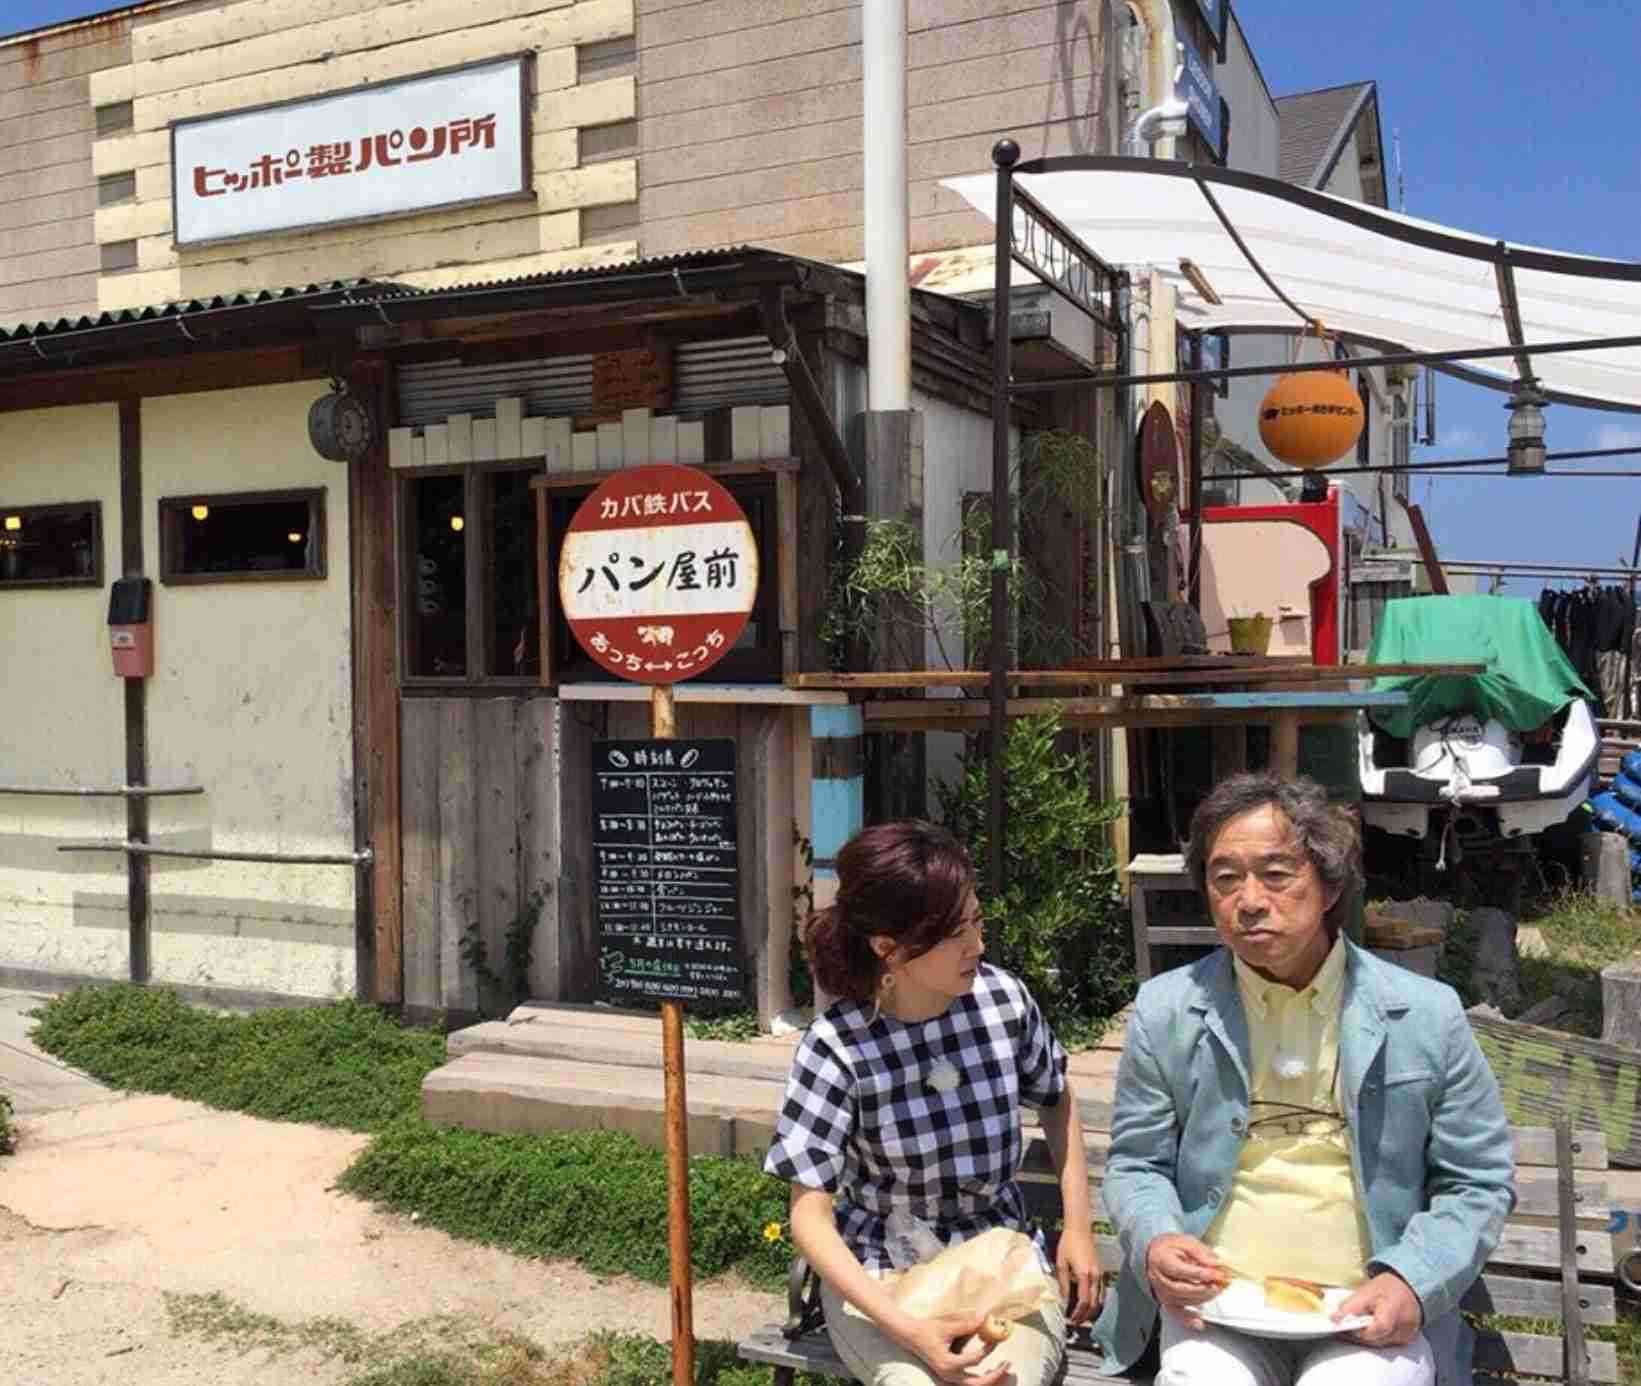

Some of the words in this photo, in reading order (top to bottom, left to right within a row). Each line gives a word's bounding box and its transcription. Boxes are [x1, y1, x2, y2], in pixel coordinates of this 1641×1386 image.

[192, 113, 497, 197] ヒッポー製パン所
[601, 491, 712, 519] カバ鉄バス
[577, 547, 739, 594] パン屋前
